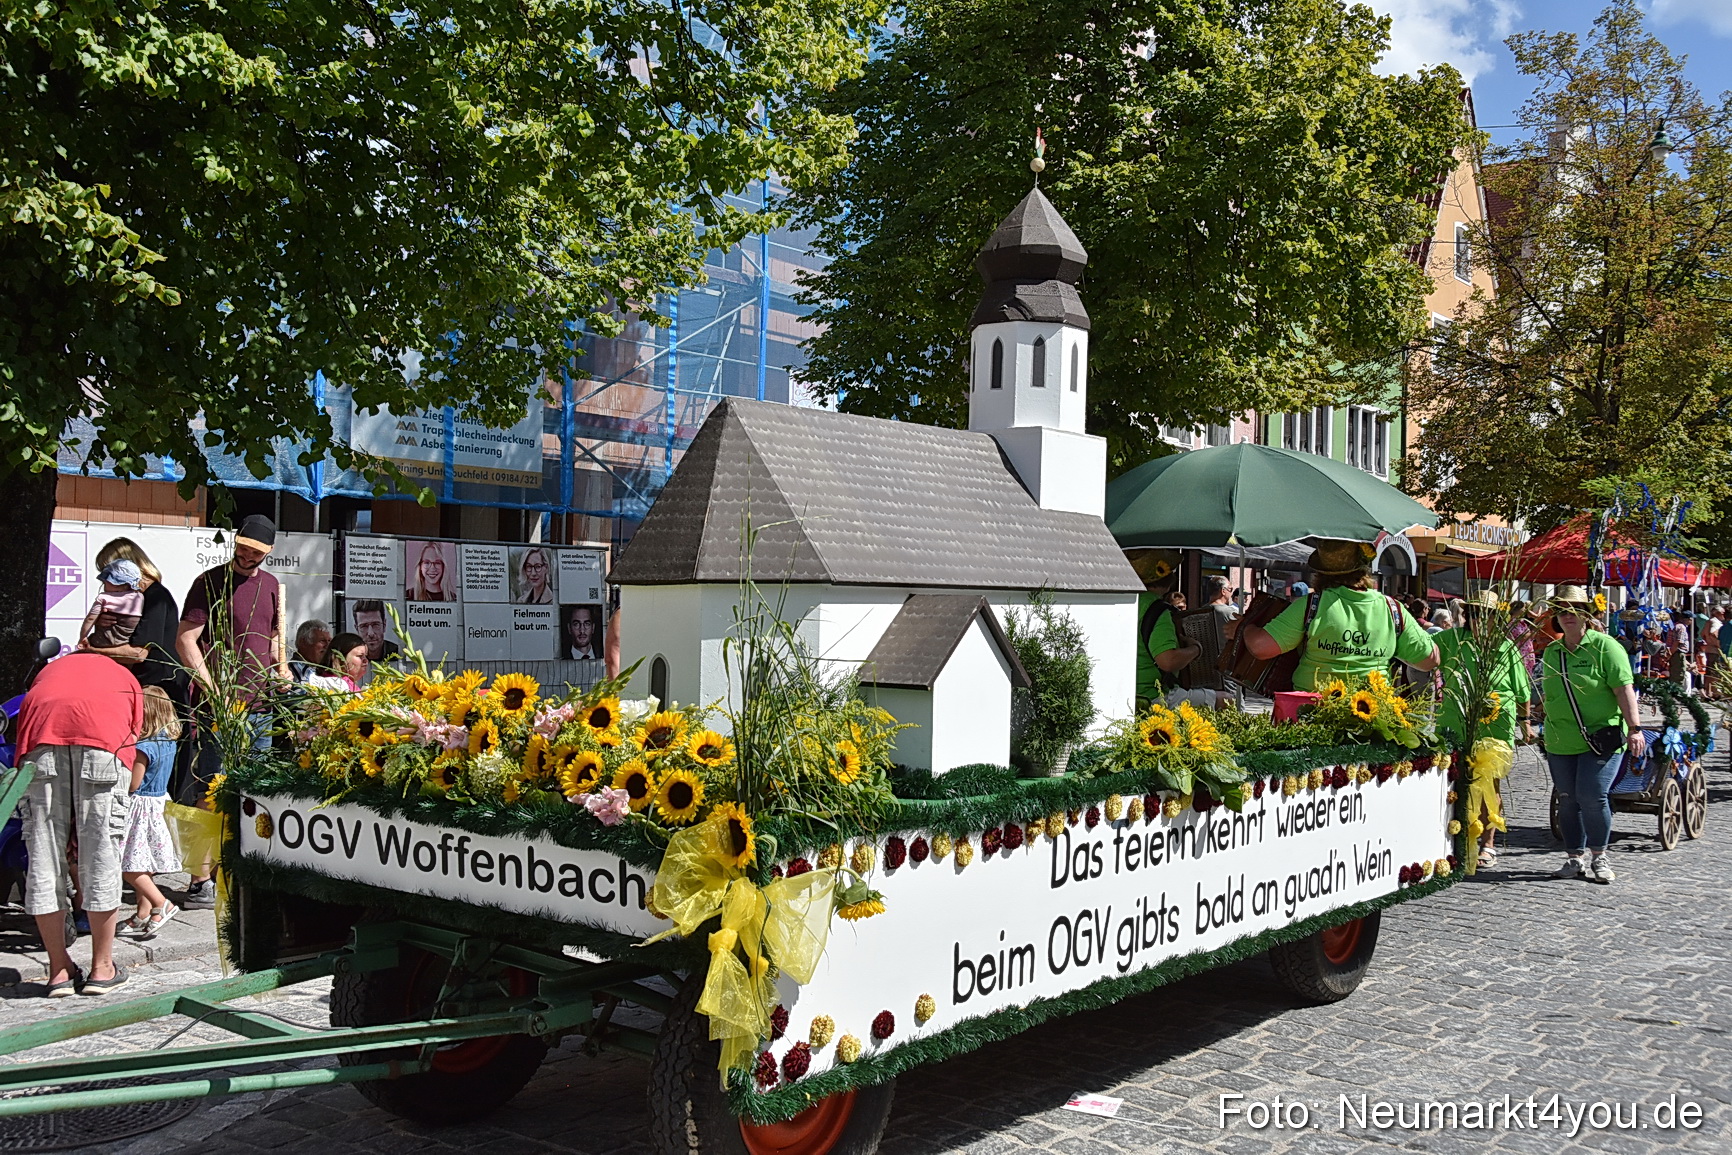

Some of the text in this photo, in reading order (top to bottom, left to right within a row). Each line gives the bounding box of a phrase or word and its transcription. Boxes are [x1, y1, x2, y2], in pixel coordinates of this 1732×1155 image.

[422, 424, 535, 448] Trapblecheindeckung
[421, 438, 503, 458] Asbesanierung
[1455, 520, 1478, 542] LEDER
[196, 537, 212, 549] FS
[265, 556, 300, 567] GmbH
[409, 604, 452, 615] Fielmann
[513, 609, 551, 618] Fielmann
[409, 618, 432, 628] baut
[514, 622, 550, 631] baut um.
[468, 626, 508, 639] fielmann
[1342, 629, 1371, 645] OGV
[1318, 639, 1371, 656] Woffenbach
[1050, 782, 1367, 889] Das feiern kehrt wieder ein,
[278, 809, 647, 911] OGV Woffenbach
[952, 838, 1392, 1006] beim OGV gibts bald an guad'n Wein
